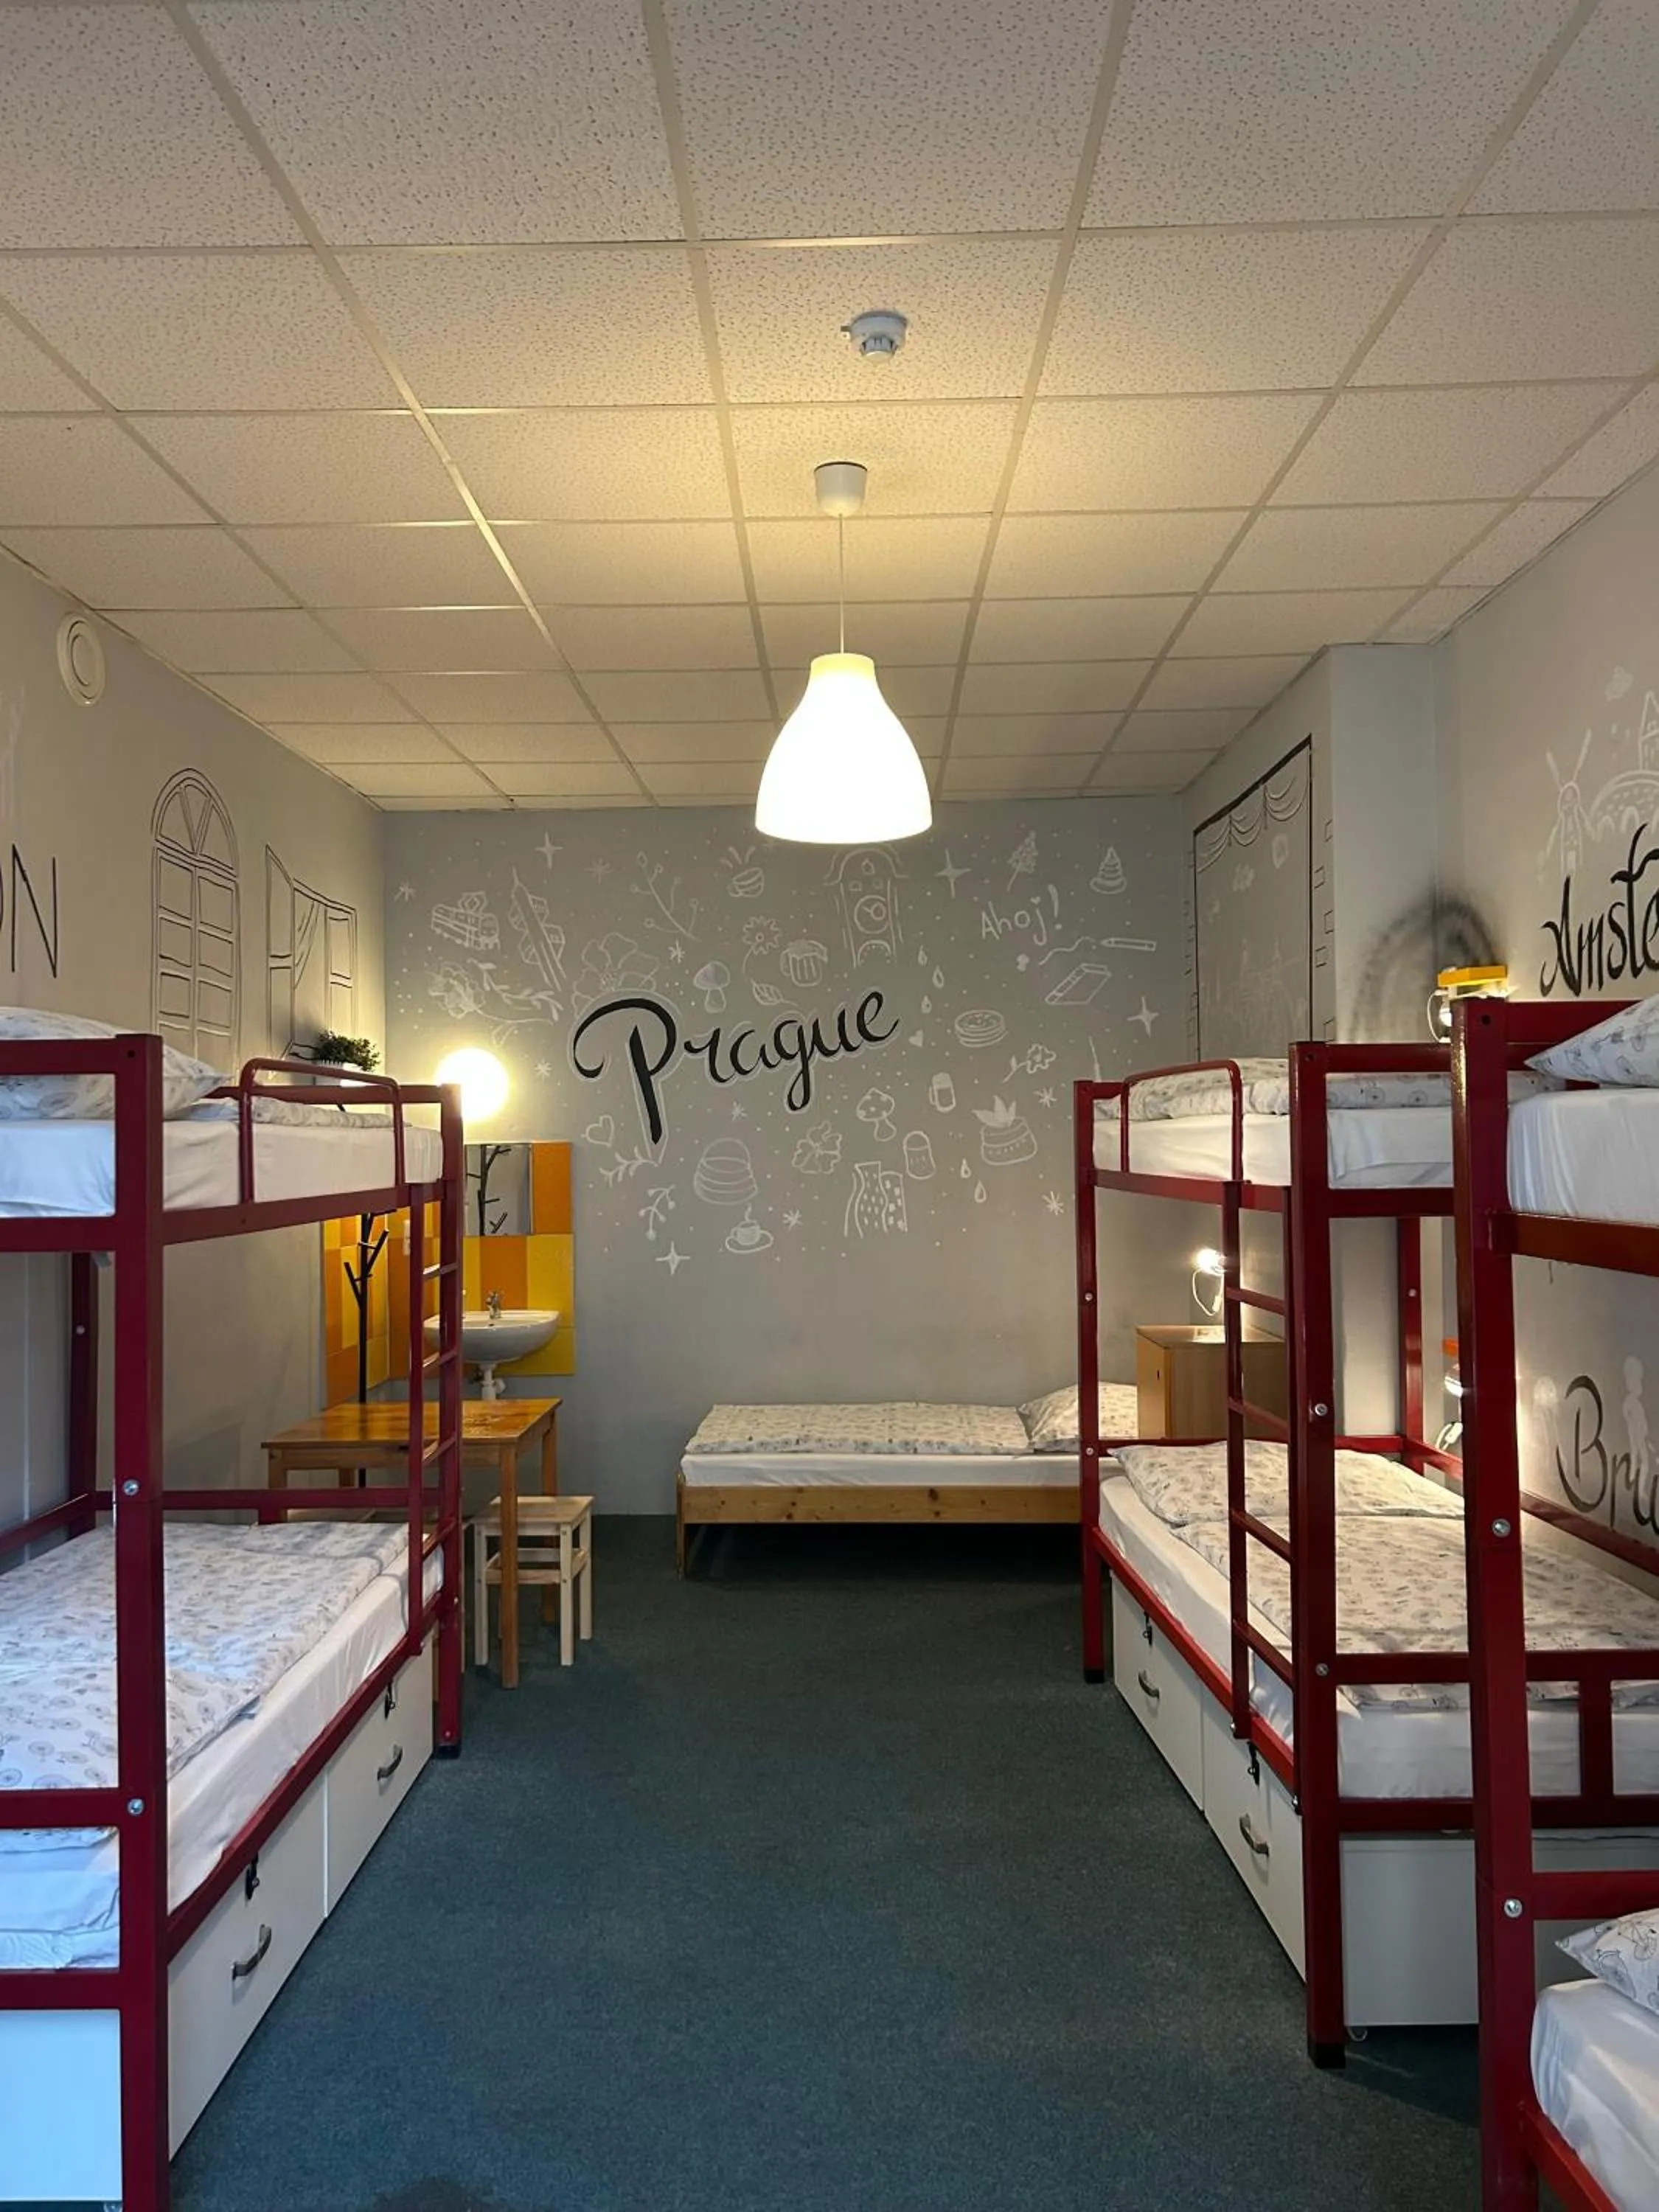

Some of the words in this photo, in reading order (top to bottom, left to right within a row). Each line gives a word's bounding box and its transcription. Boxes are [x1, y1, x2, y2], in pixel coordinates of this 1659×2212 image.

[0, 843, 57, 978] N
[981, 884, 1062, 946] Ahoj!
[573, 991, 900, 1145] Prague
